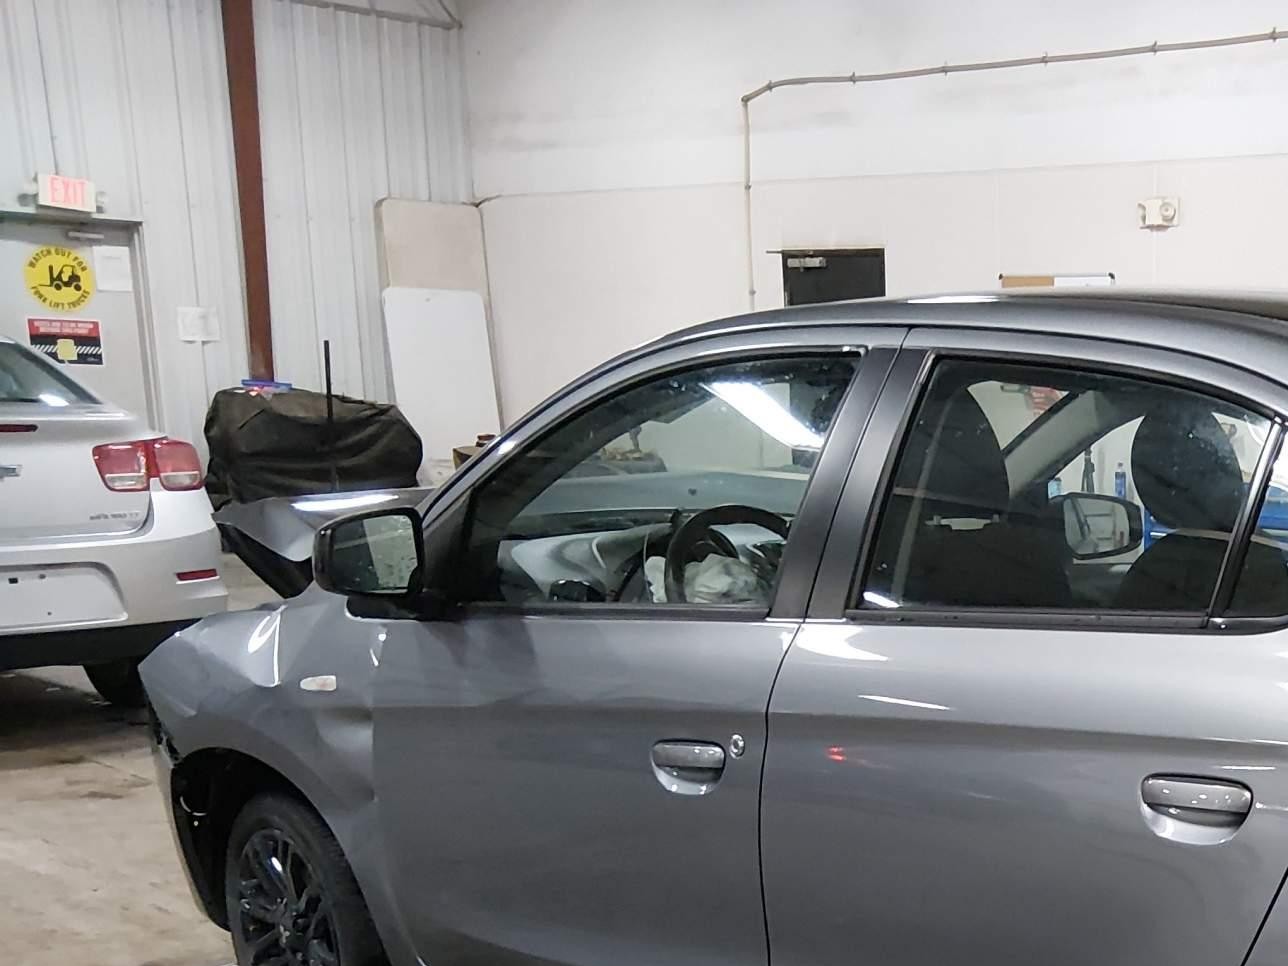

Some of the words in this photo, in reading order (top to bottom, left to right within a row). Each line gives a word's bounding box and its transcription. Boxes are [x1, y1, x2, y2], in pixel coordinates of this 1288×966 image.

[50, 176, 88, 208] EXIT
[28, 248, 52, 268] WATCH
[55, 248, 72, 258] OUT
[72, 256, 88, 272] FOR
[31, 286, 47, 303] FORK
[49, 300, 65, 310] LIFT
